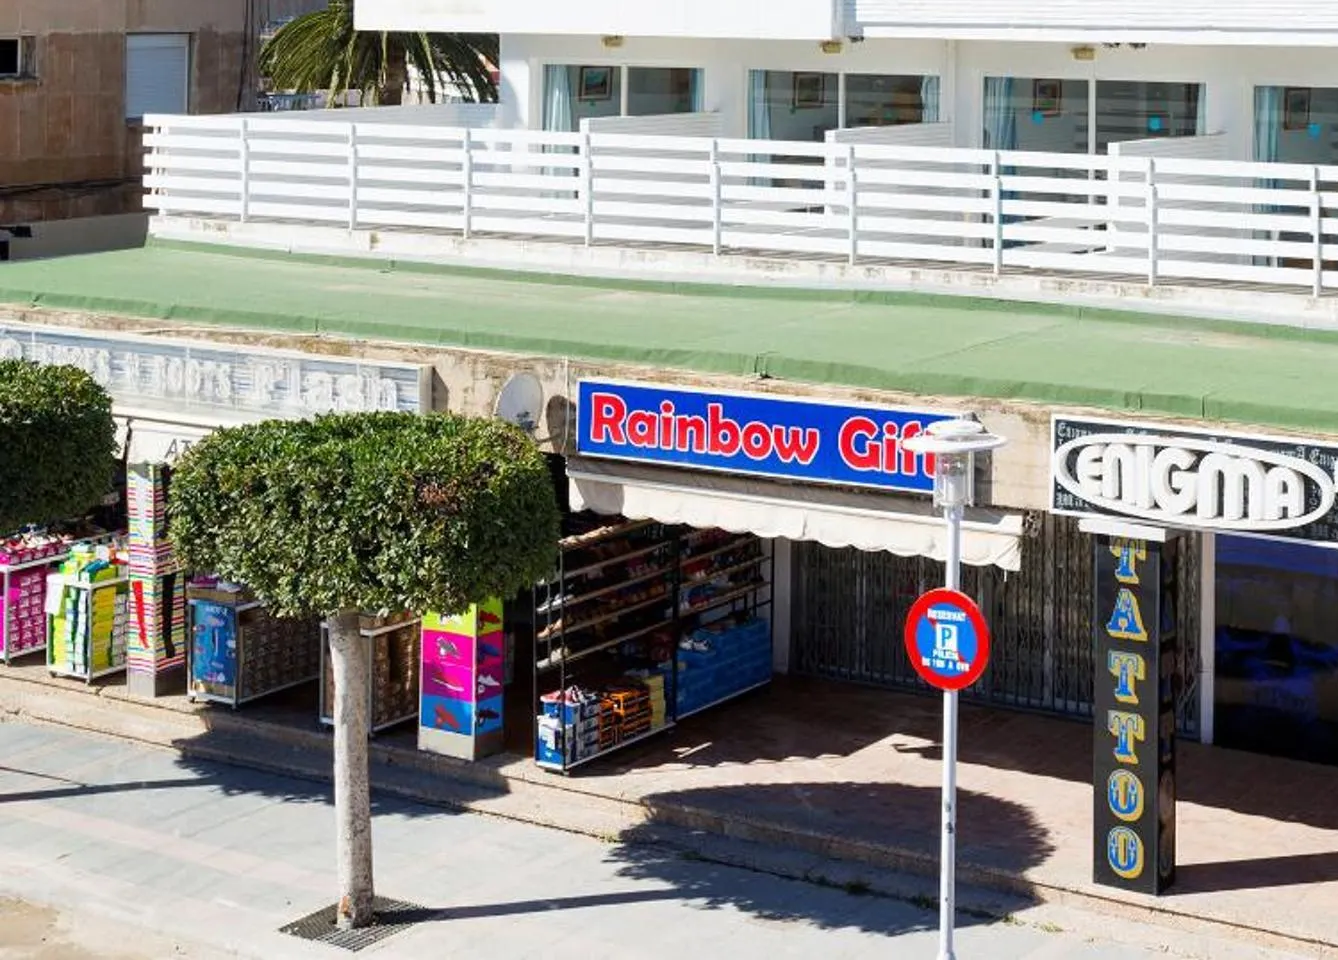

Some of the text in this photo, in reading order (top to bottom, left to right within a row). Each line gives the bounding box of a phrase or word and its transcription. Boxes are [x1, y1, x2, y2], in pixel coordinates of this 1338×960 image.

[590, 392, 819, 464] Rainbow
[1077, 442, 1306, 520] ENIGMA
[1106, 536, 1148, 878] TATTOO
